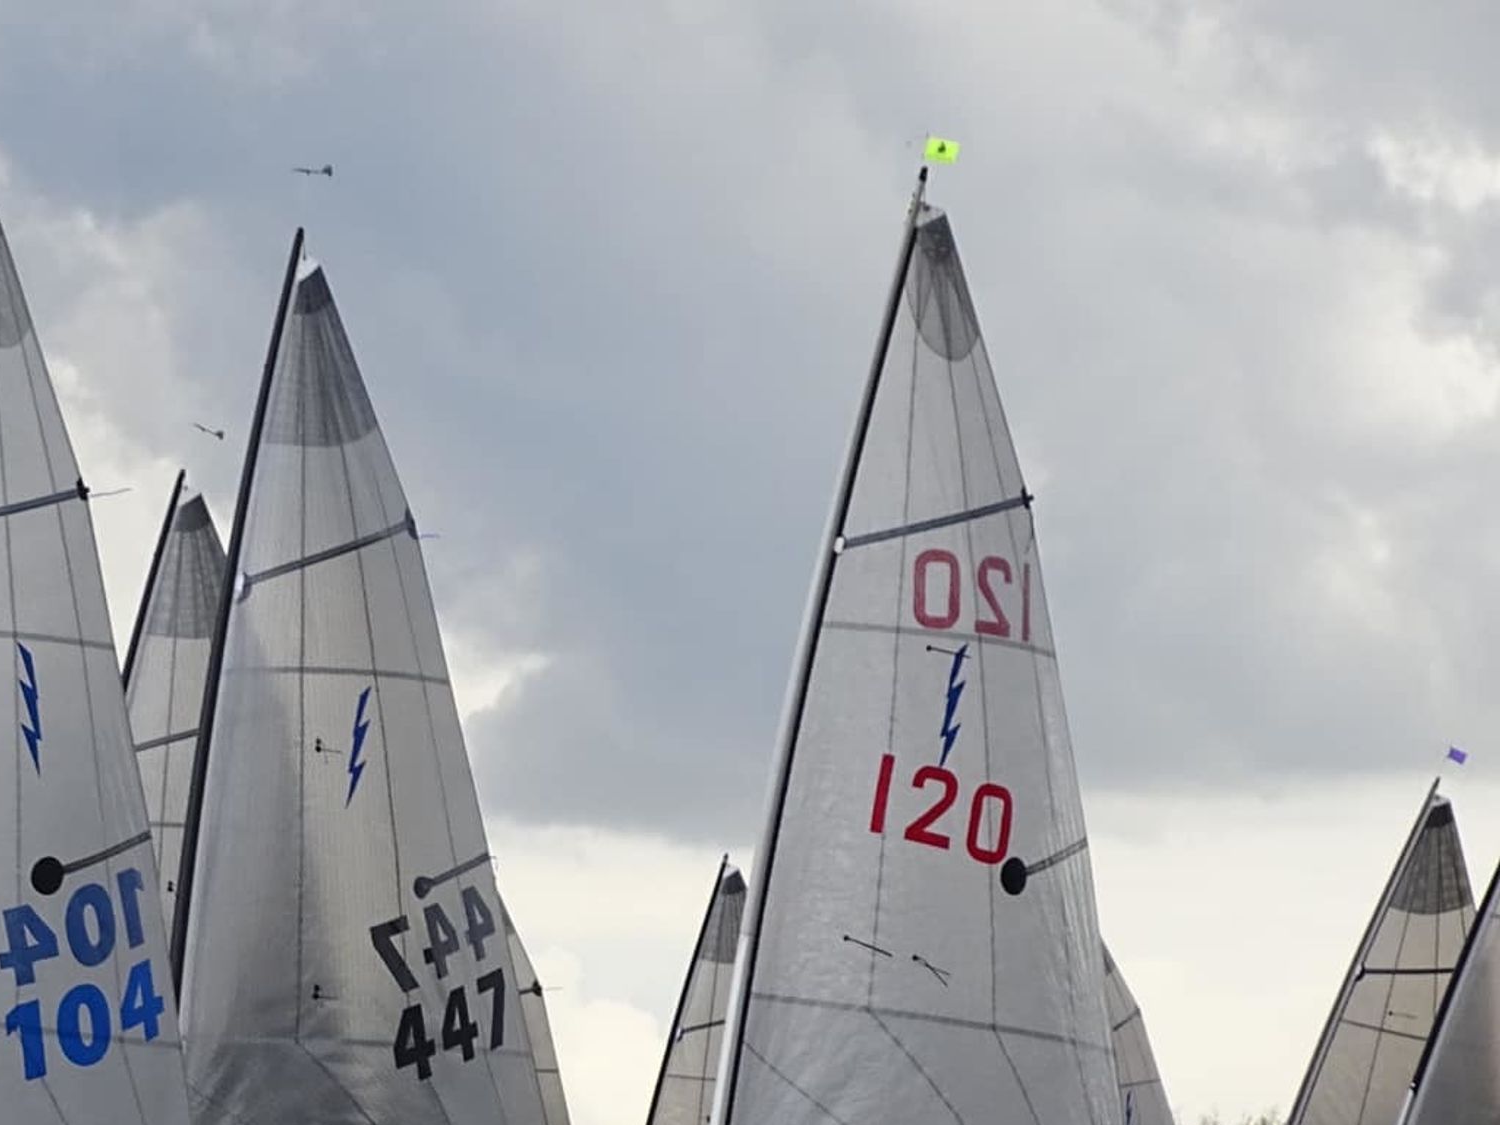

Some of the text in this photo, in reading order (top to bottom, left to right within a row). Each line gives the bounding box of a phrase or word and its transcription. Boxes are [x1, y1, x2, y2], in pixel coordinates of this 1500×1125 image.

[870, 753, 1013, 864] 120
[6, 959, 164, 1080] 104
[393, 968, 506, 1081] 447
